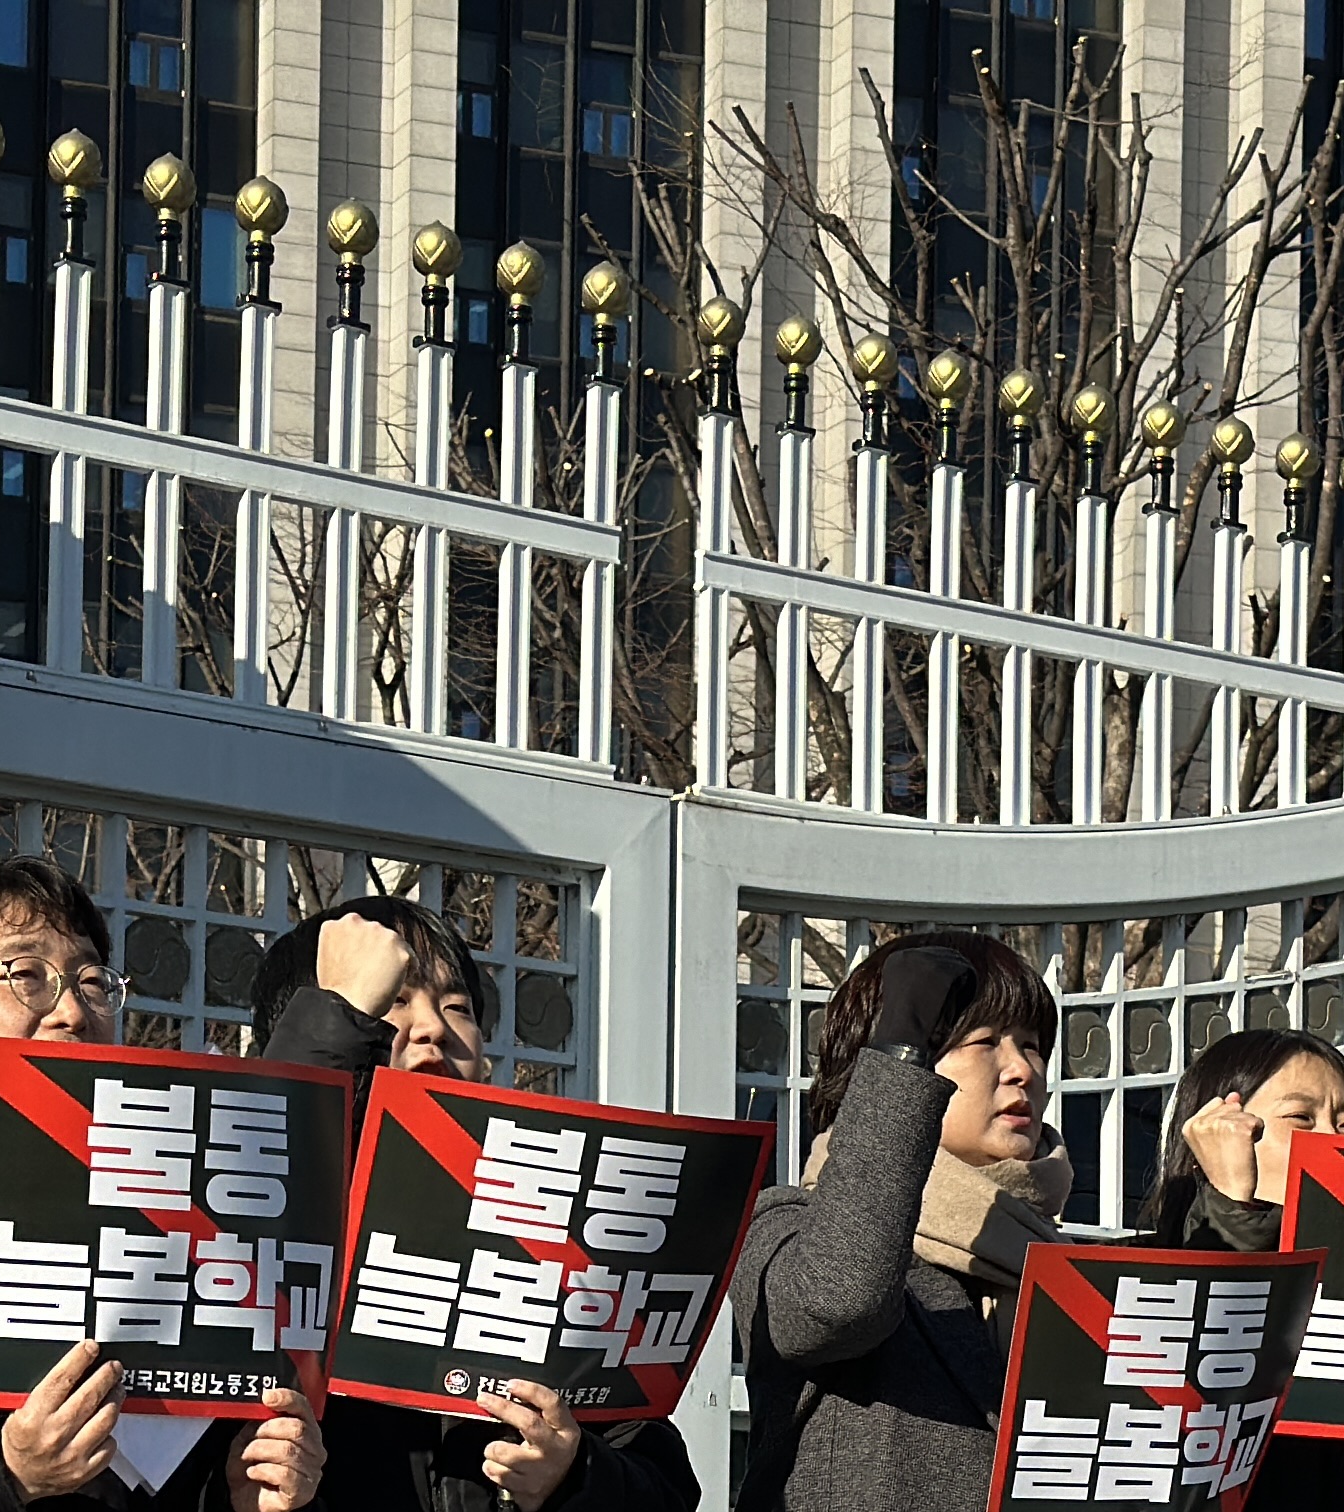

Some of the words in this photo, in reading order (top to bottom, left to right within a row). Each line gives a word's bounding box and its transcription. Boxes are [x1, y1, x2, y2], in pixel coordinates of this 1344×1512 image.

[87, 1077, 290, 1218] 불통
[467, 1117, 687, 1253] 불통
[350, 1231, 715, 1368] 늘봄학교
[1103, 1276, 1272, 1389] 불통
[1011, 1397, 1277, 1503] 늘봄학교
